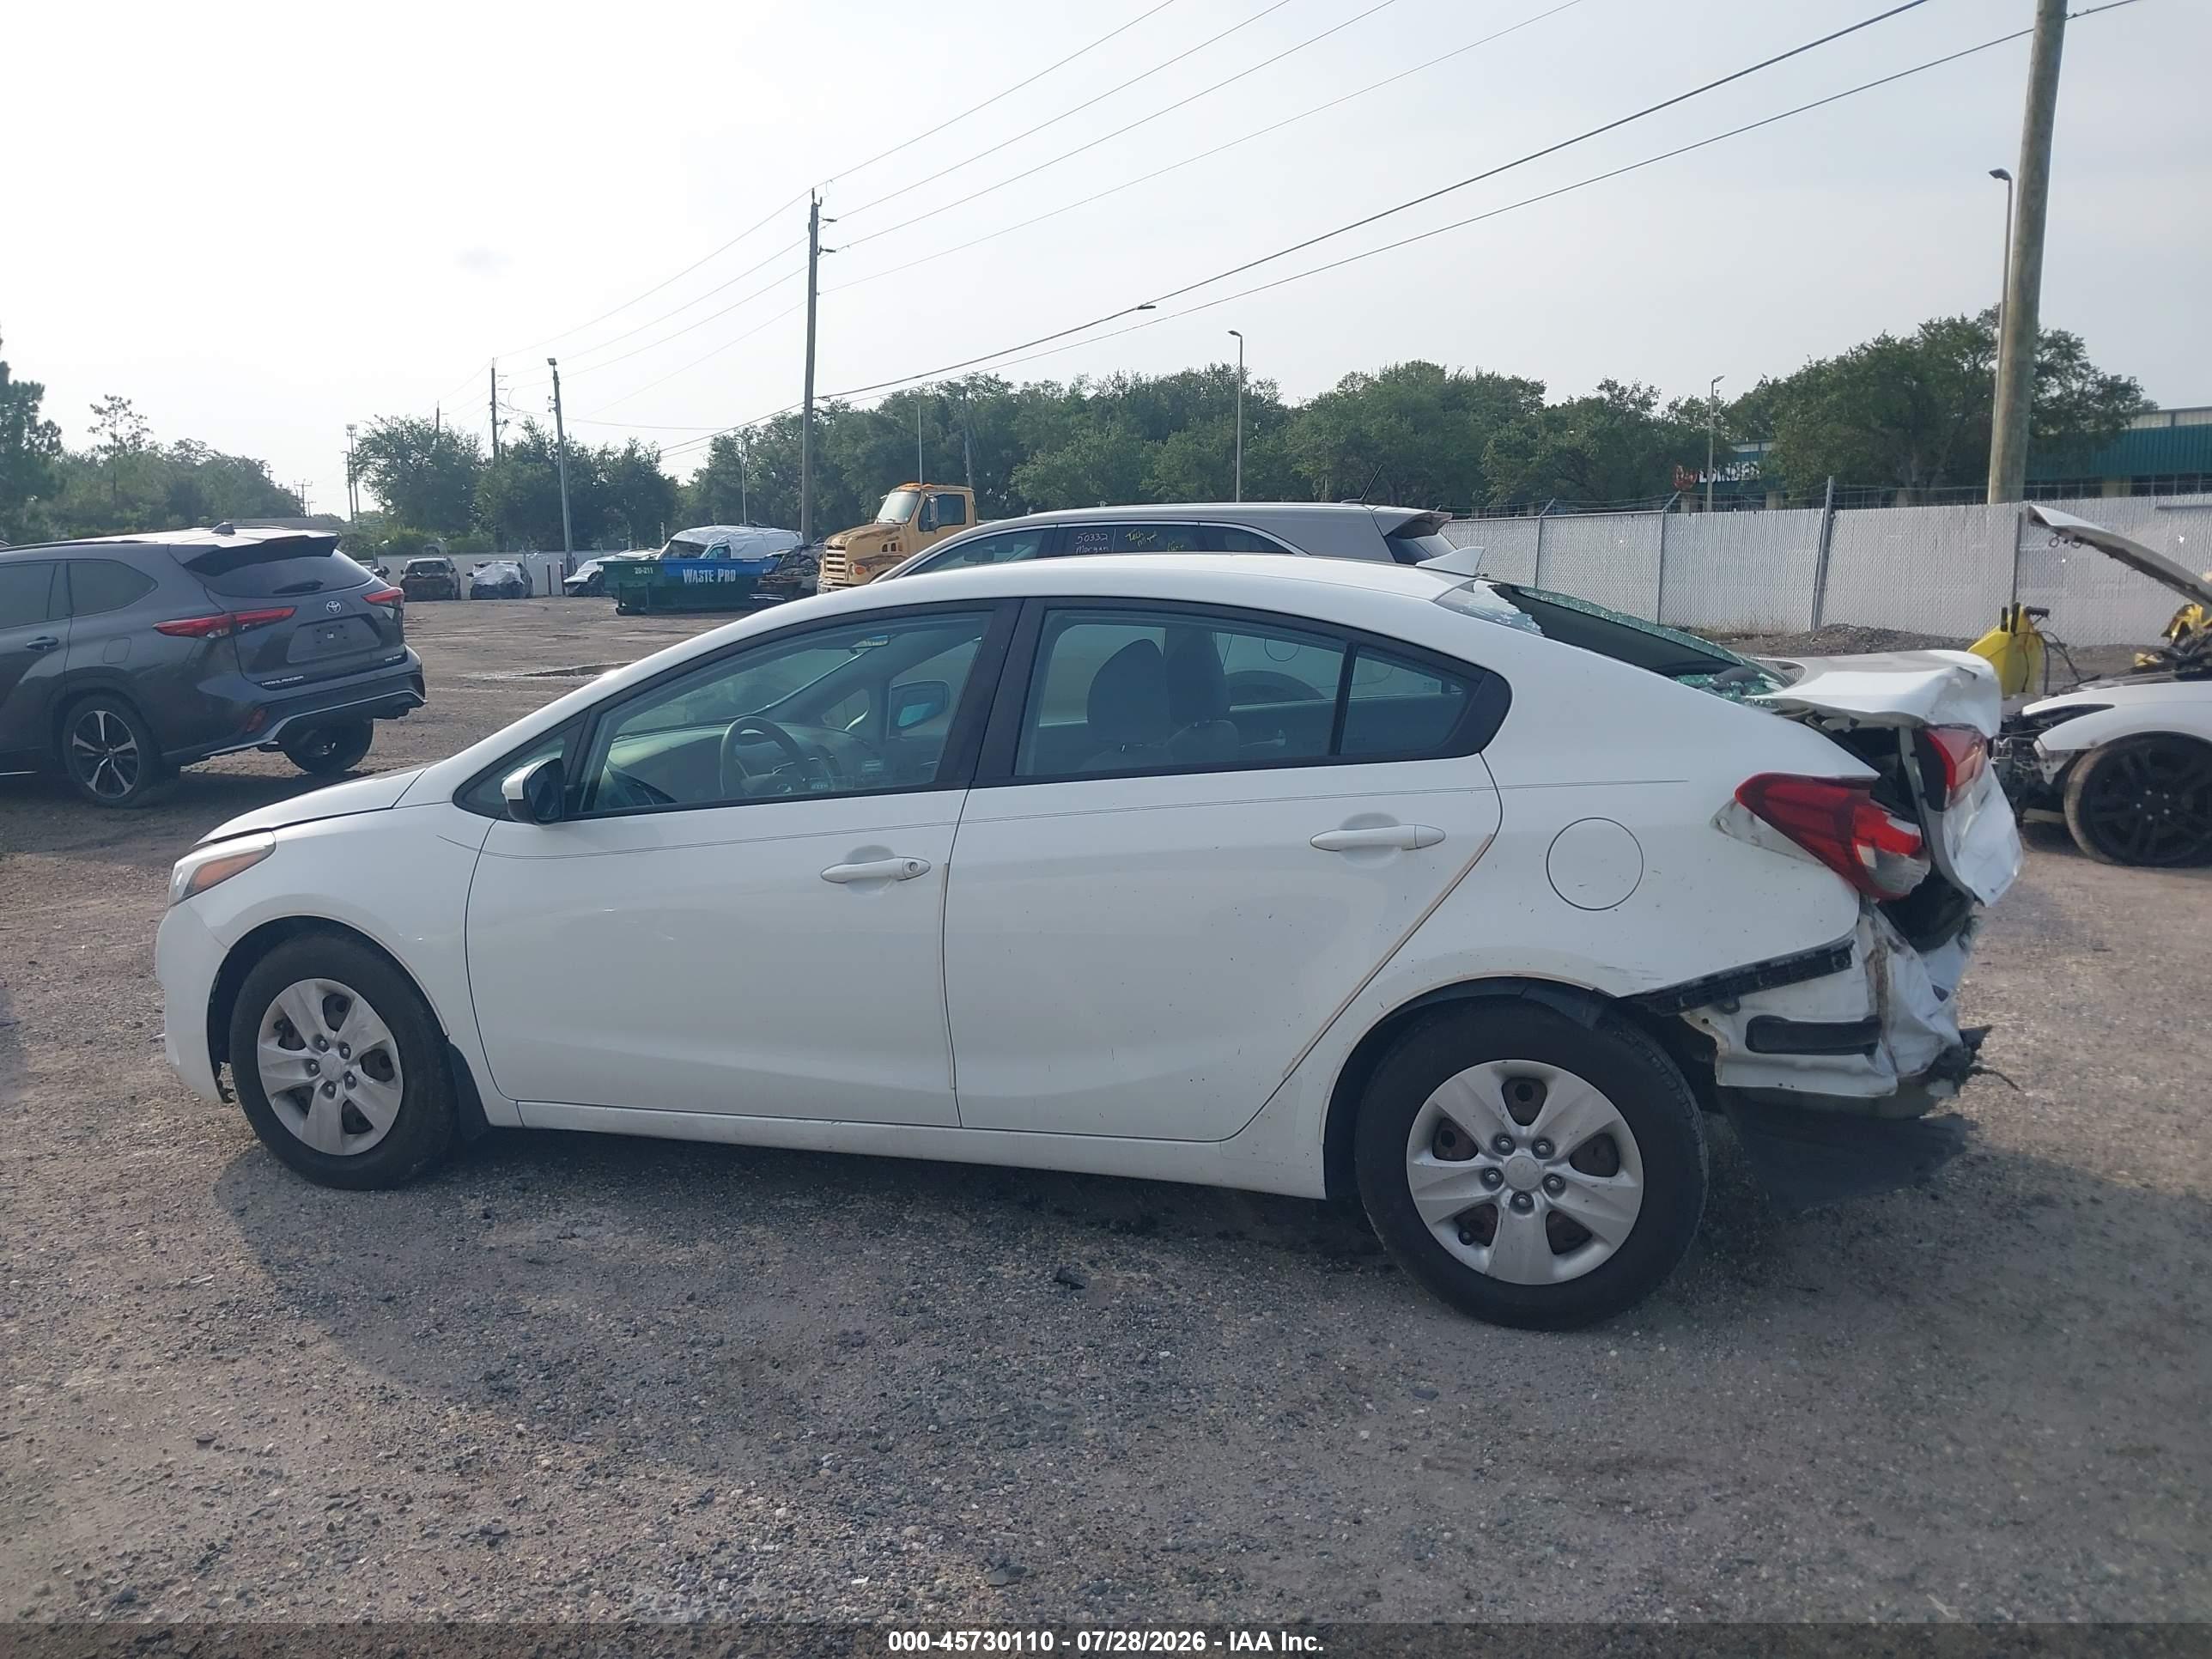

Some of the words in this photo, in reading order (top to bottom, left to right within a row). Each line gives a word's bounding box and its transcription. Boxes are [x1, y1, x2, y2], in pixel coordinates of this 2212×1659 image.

[1075, 532, 1108, 544] 50332
[683, 568, 714, 584] WASTE
[717, 568, 737, 583] PRO
